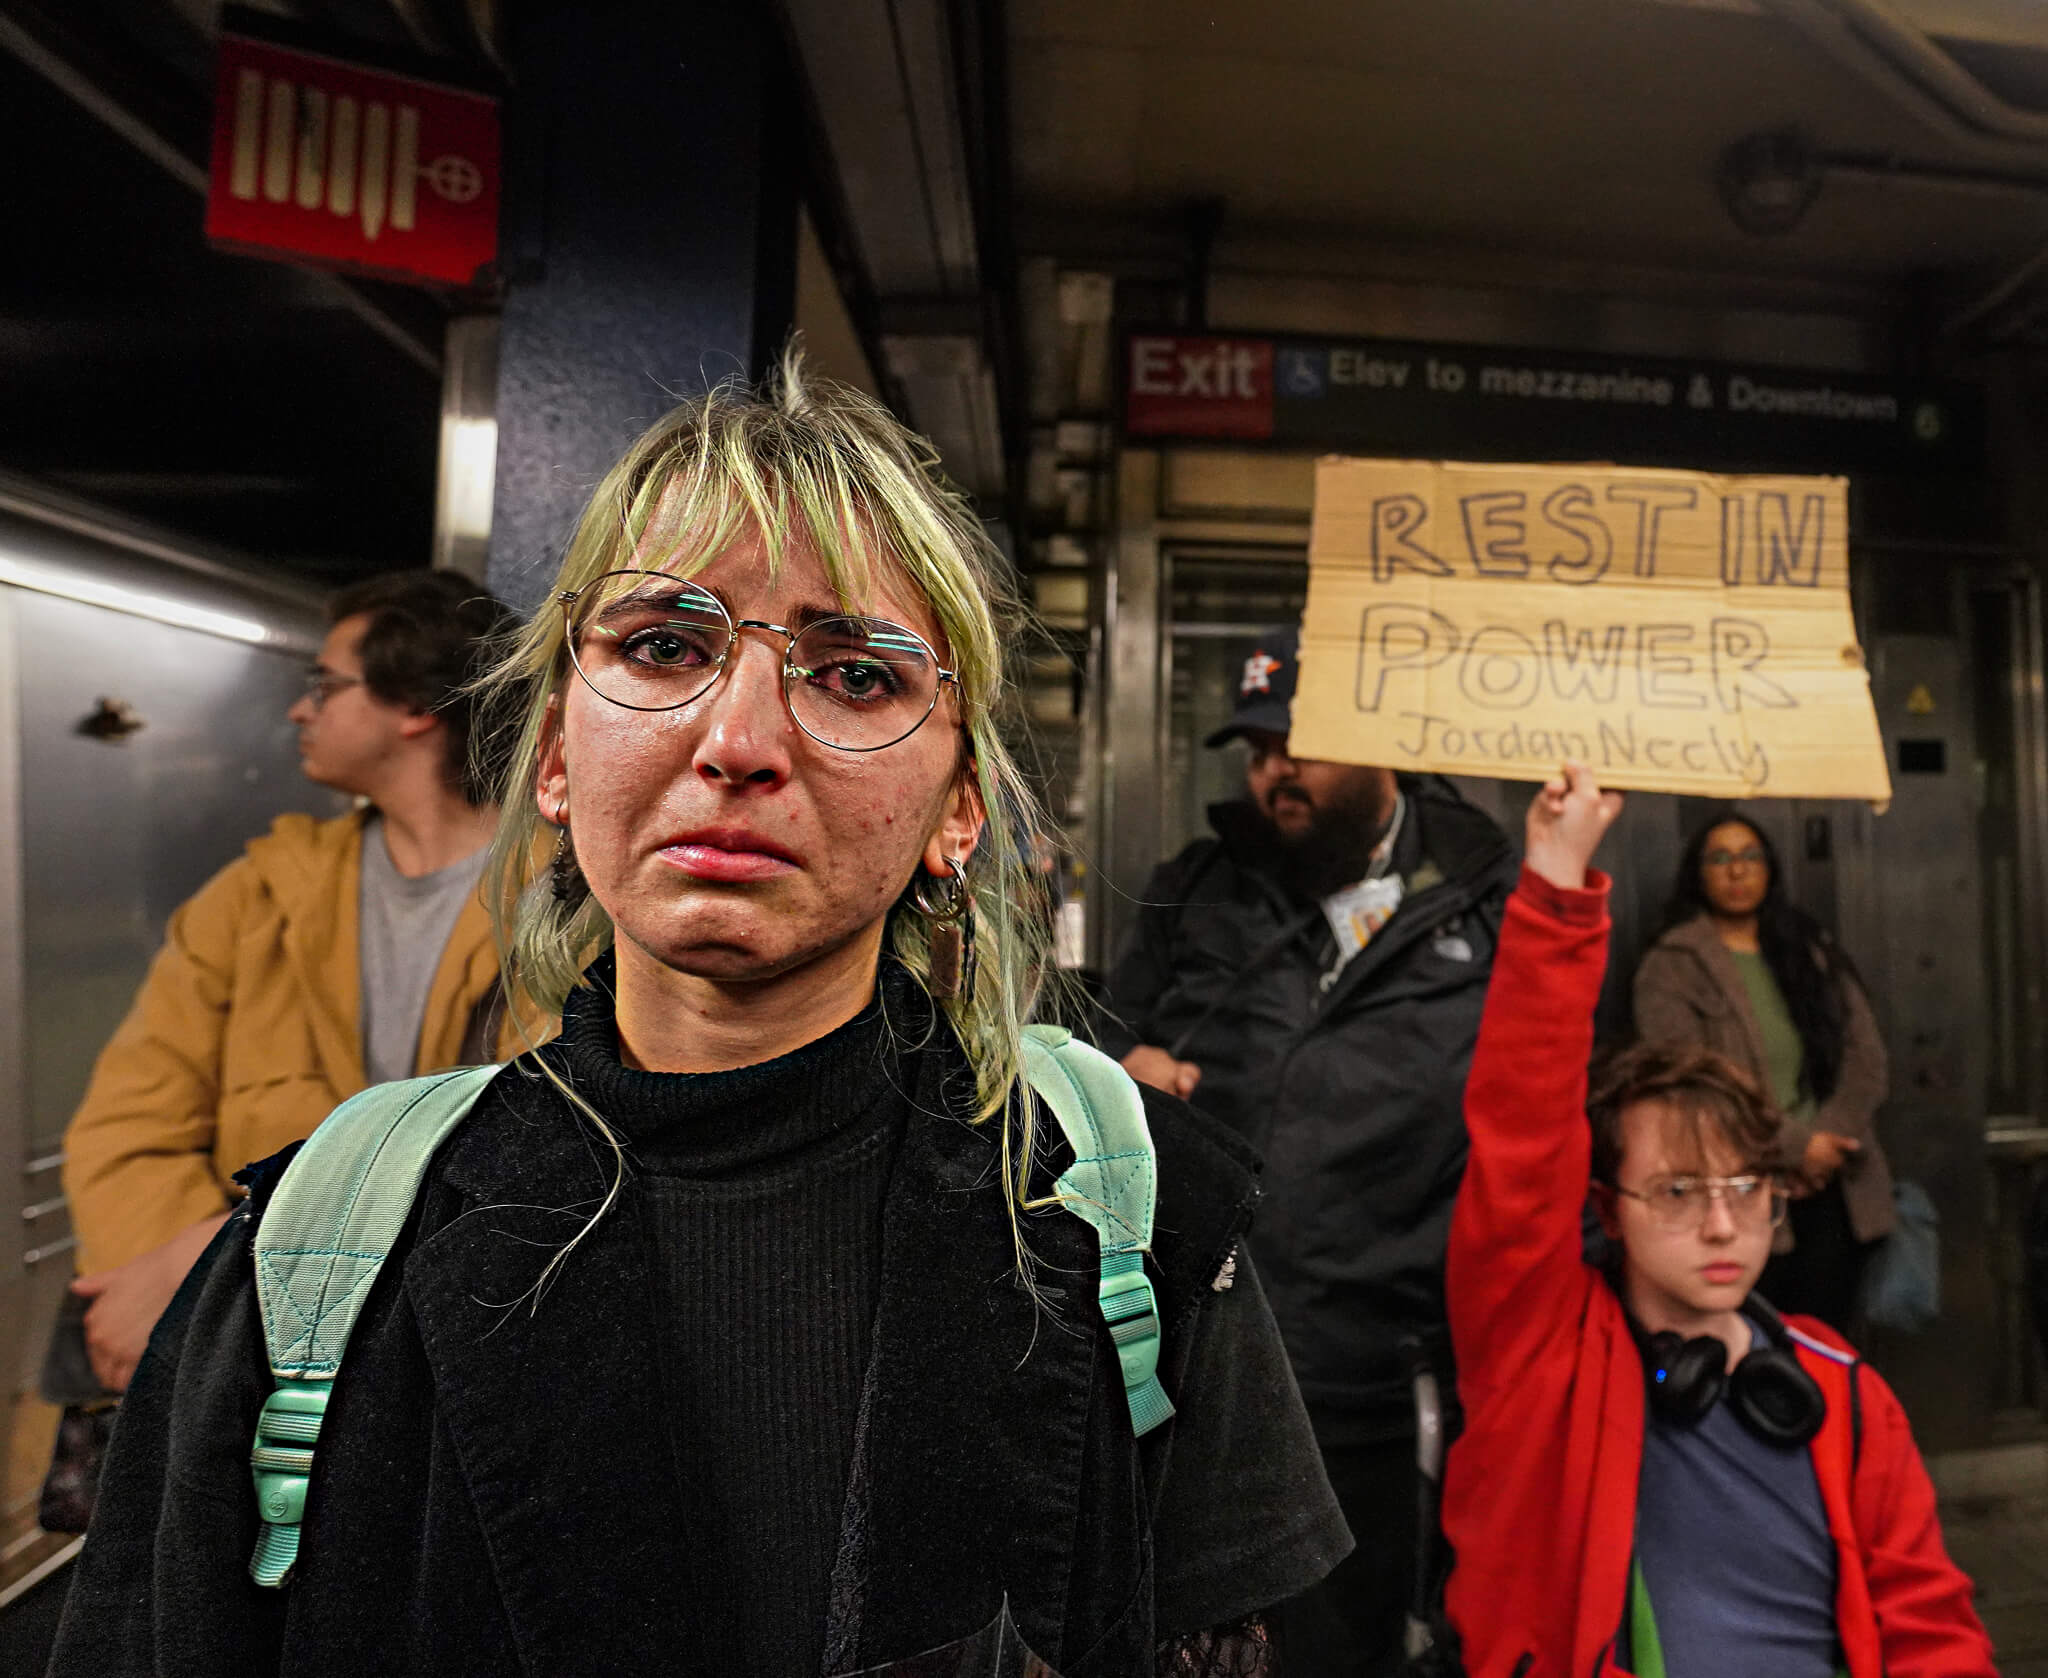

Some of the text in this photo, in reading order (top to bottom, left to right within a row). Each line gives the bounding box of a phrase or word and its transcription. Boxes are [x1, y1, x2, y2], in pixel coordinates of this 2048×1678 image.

[1130, 336, 1256, 399] Exit
[1329, 349, 1411, 387] Elev
[1427, 357, 1467, 392] to
[1480, 366, 1675, 407] mezzanine
[1687, 372, 1714, 410] &
[1727, 375, 1898, 422] Downtown
[1370, 483, 1825, 588] REST IN
[1355, 602, 1799, 715] POWER
[1395, 710, 1590, 763] Jordan
